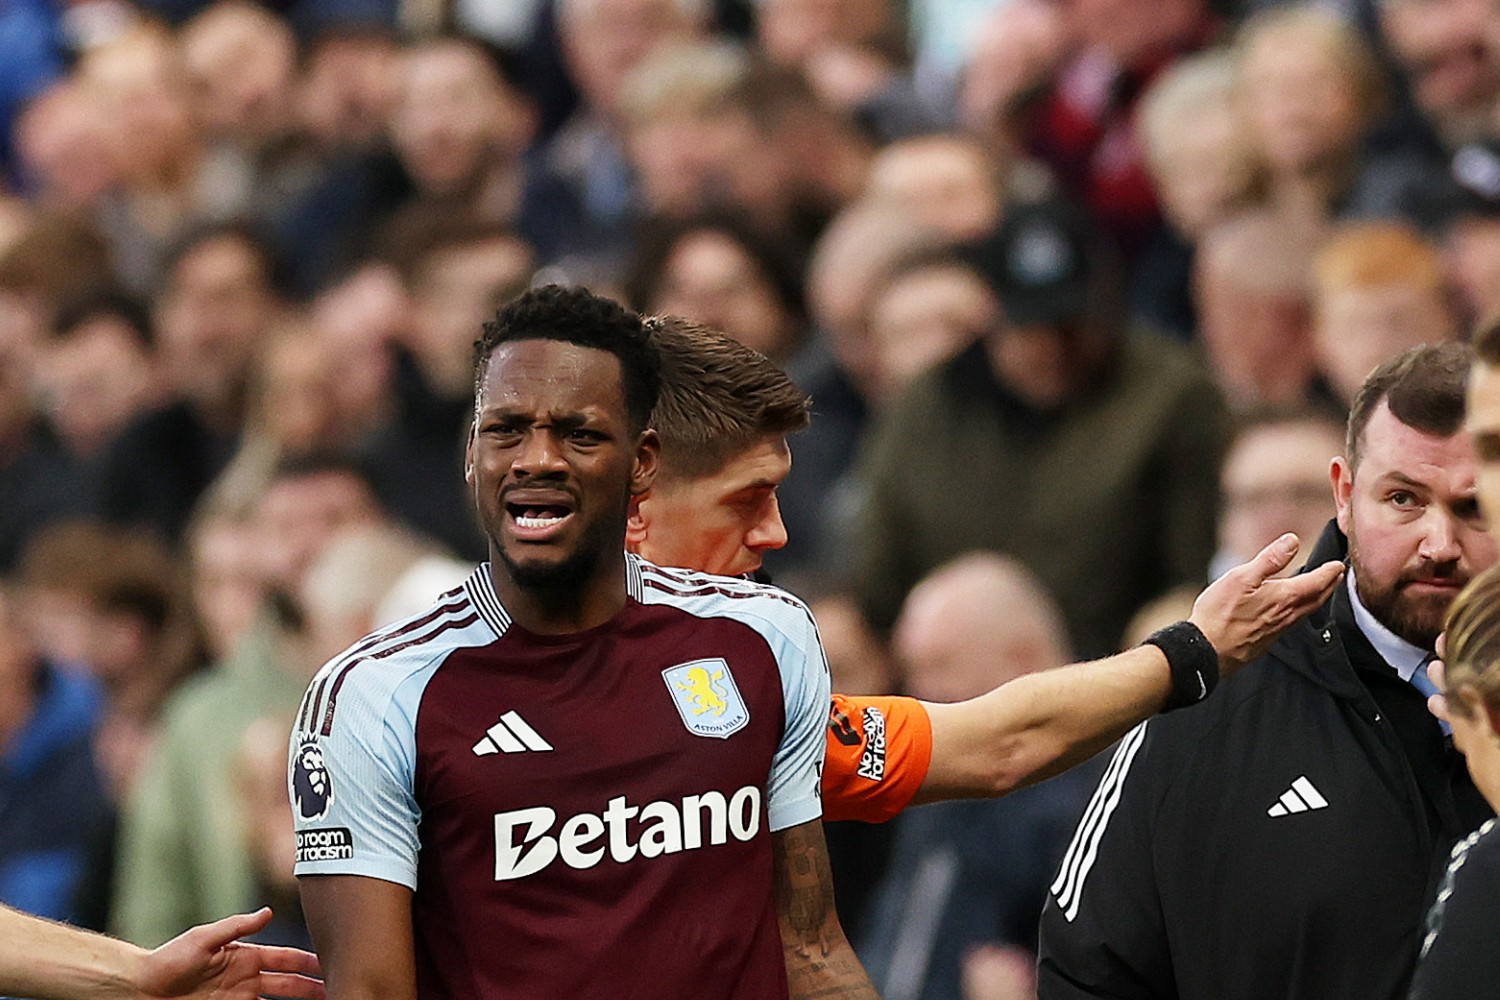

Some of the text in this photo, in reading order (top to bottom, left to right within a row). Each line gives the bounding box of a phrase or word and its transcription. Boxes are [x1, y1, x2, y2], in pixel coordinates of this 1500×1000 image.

[694, 715, 743, 732] ASTON VILLA
[857, 752, 872, 777] No
[869, 755, 884, 781] for
[304, 830, 346, 847] room
[494, 786, 761, 881] Betano
[304, 845, 353, 861] racism
